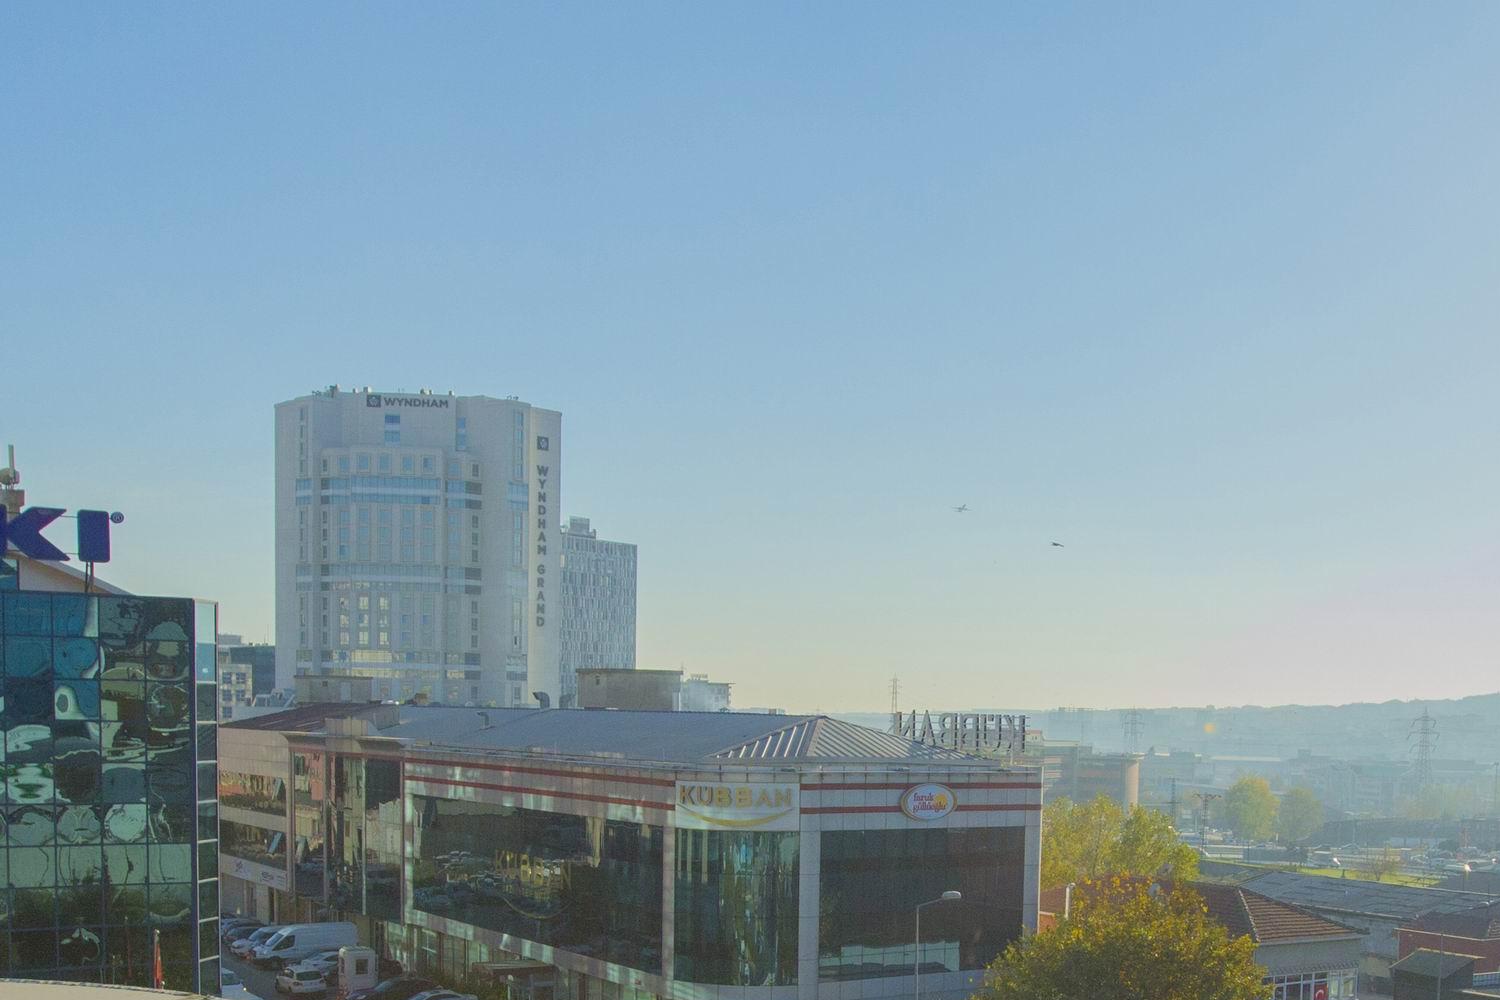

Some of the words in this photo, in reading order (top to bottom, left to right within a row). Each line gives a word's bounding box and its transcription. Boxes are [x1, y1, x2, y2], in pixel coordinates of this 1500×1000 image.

[384, 397, 449, 408] WYNDHAM
[537, 465, 549, 555] WYNDHAM
[536, 564, 545, 627] GRAND
[679, 784, 793, 808] KÜBBAN
